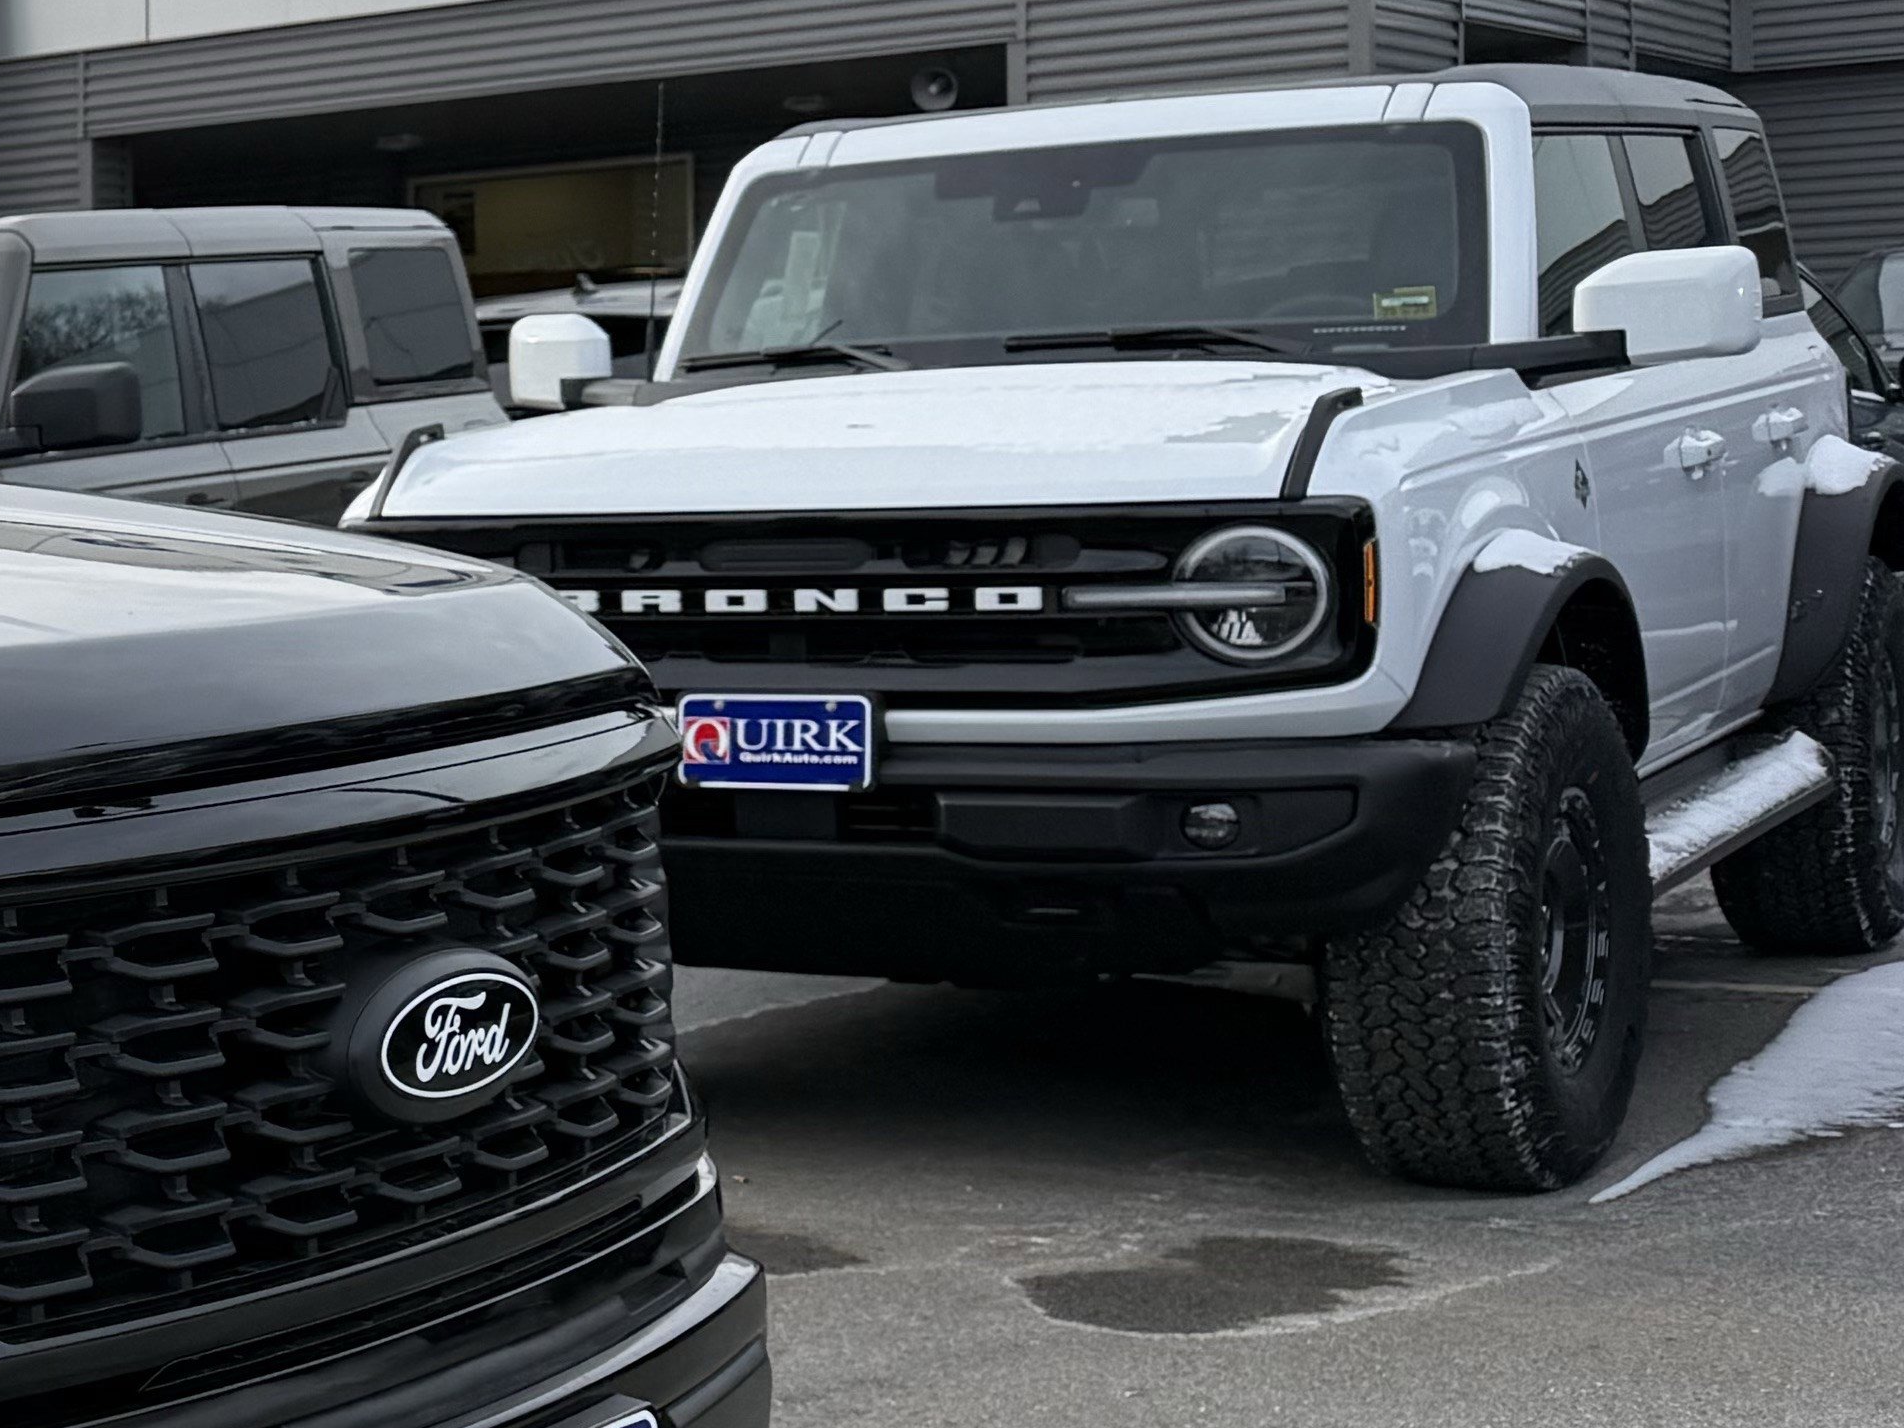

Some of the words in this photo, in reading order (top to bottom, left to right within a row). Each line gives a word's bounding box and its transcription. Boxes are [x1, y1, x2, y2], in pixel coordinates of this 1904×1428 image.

[684, 718, 864, 764] QUIRK
[739, 752, 858, 765] QuirkAuto.com
[415, 991, 511, 1083] Ford
